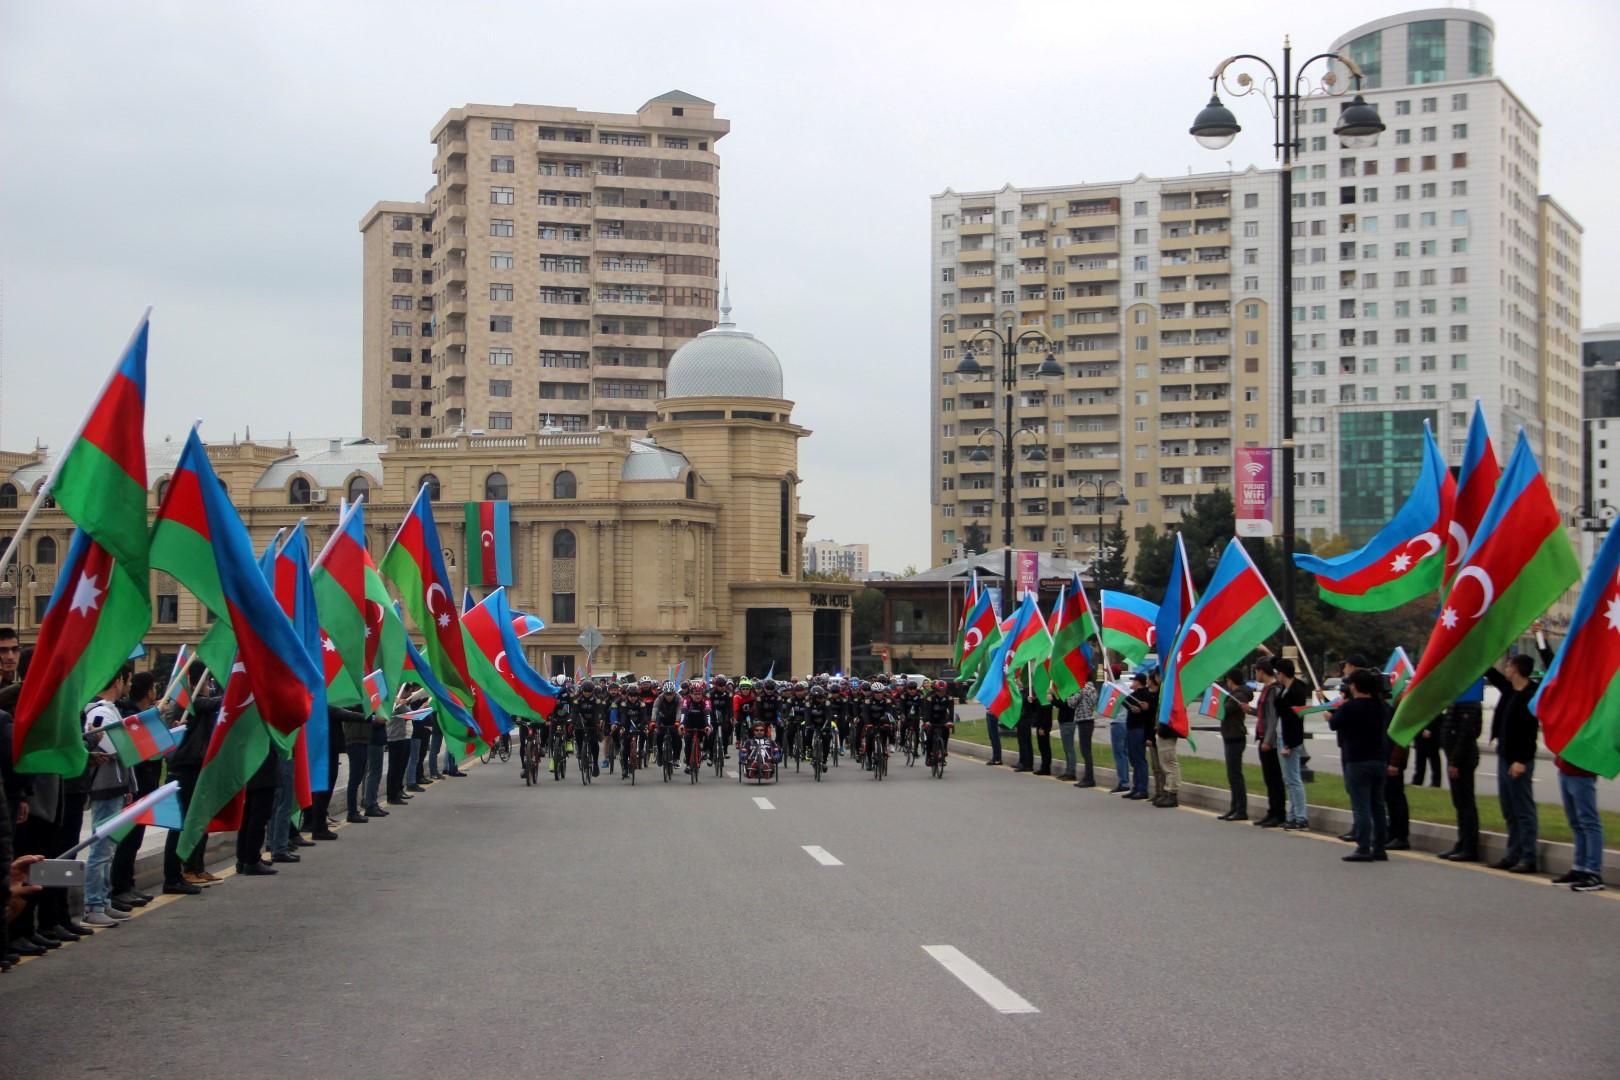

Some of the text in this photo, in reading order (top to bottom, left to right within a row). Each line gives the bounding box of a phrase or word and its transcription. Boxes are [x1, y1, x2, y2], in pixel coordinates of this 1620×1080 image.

[1243, 490, 1265, 499] WiFi
[810, 592, 850, 608] PARK HOTEL
